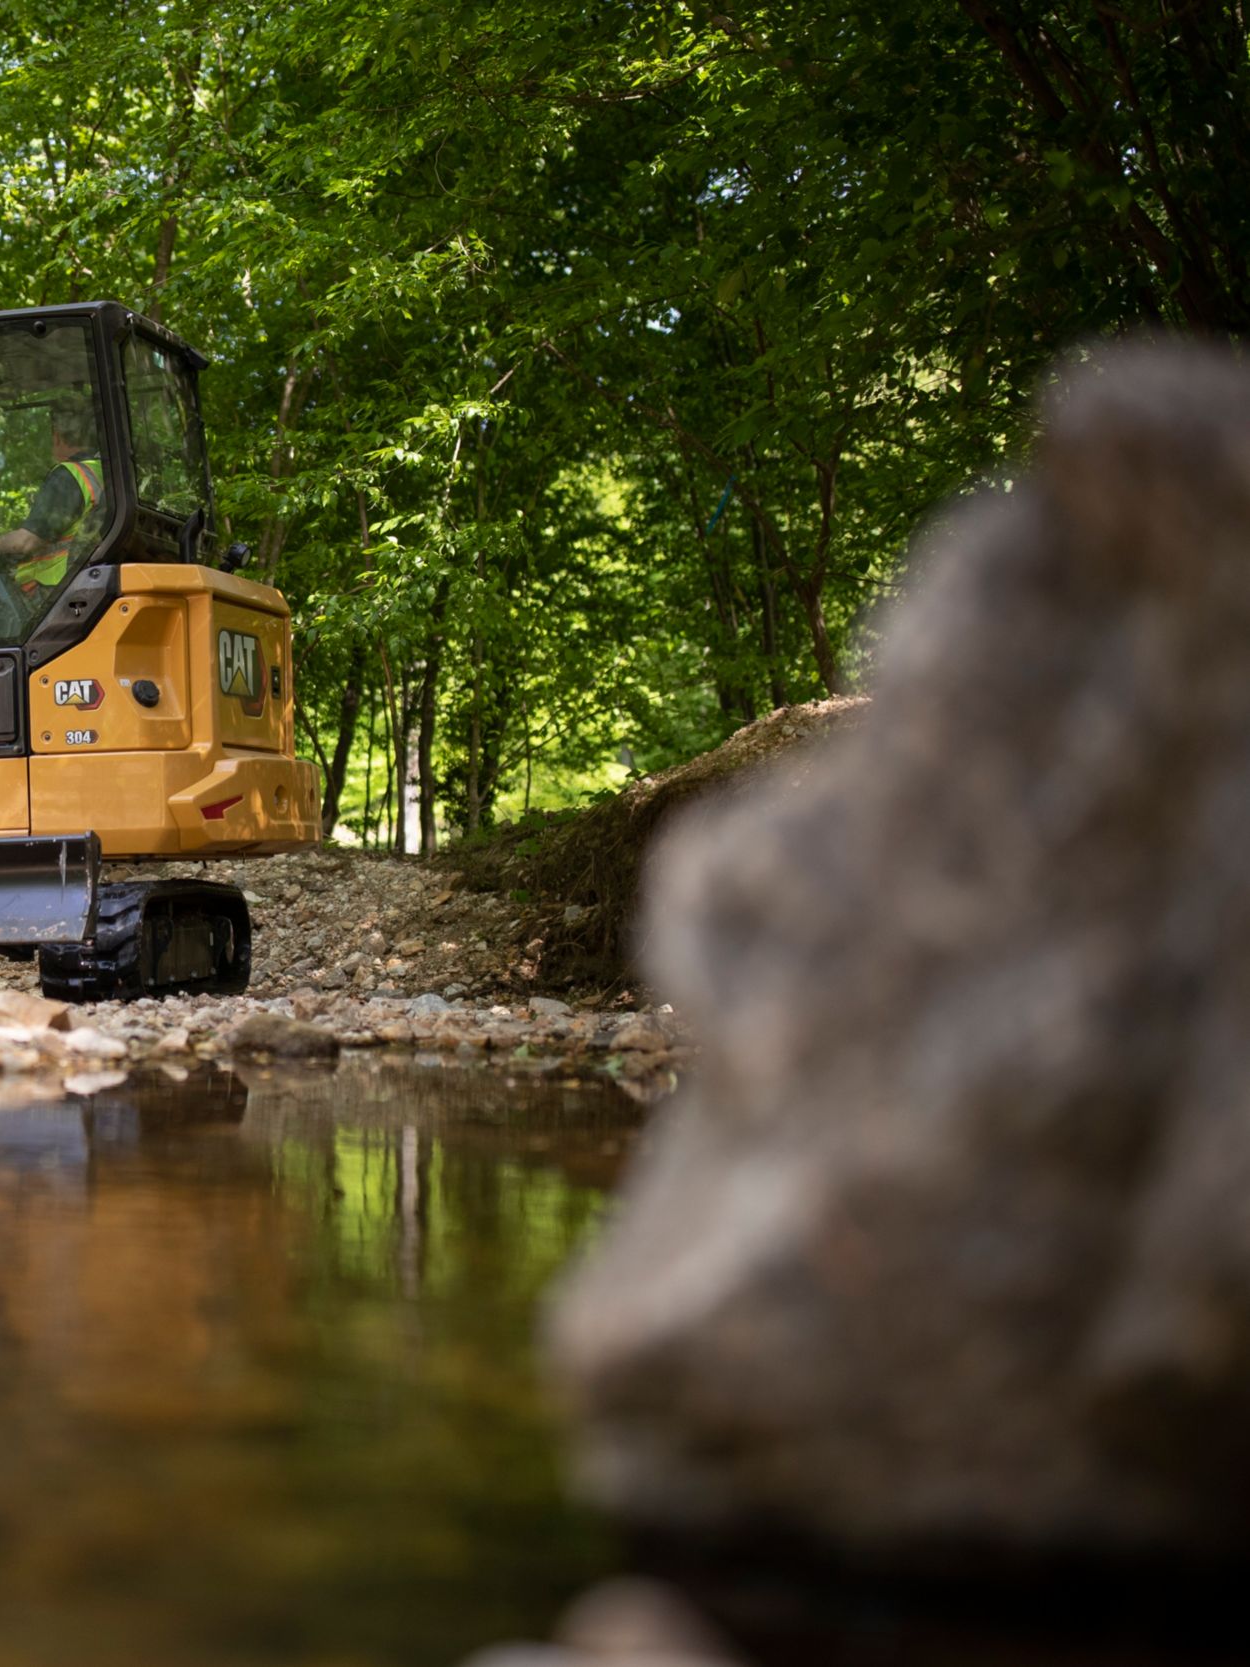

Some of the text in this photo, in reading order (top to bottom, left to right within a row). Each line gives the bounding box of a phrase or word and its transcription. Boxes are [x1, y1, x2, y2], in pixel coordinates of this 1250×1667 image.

[219, 630, 255, 696] CAT
[55, 680, 92, 705] CAT
[66, 731, 91, 744] 304
